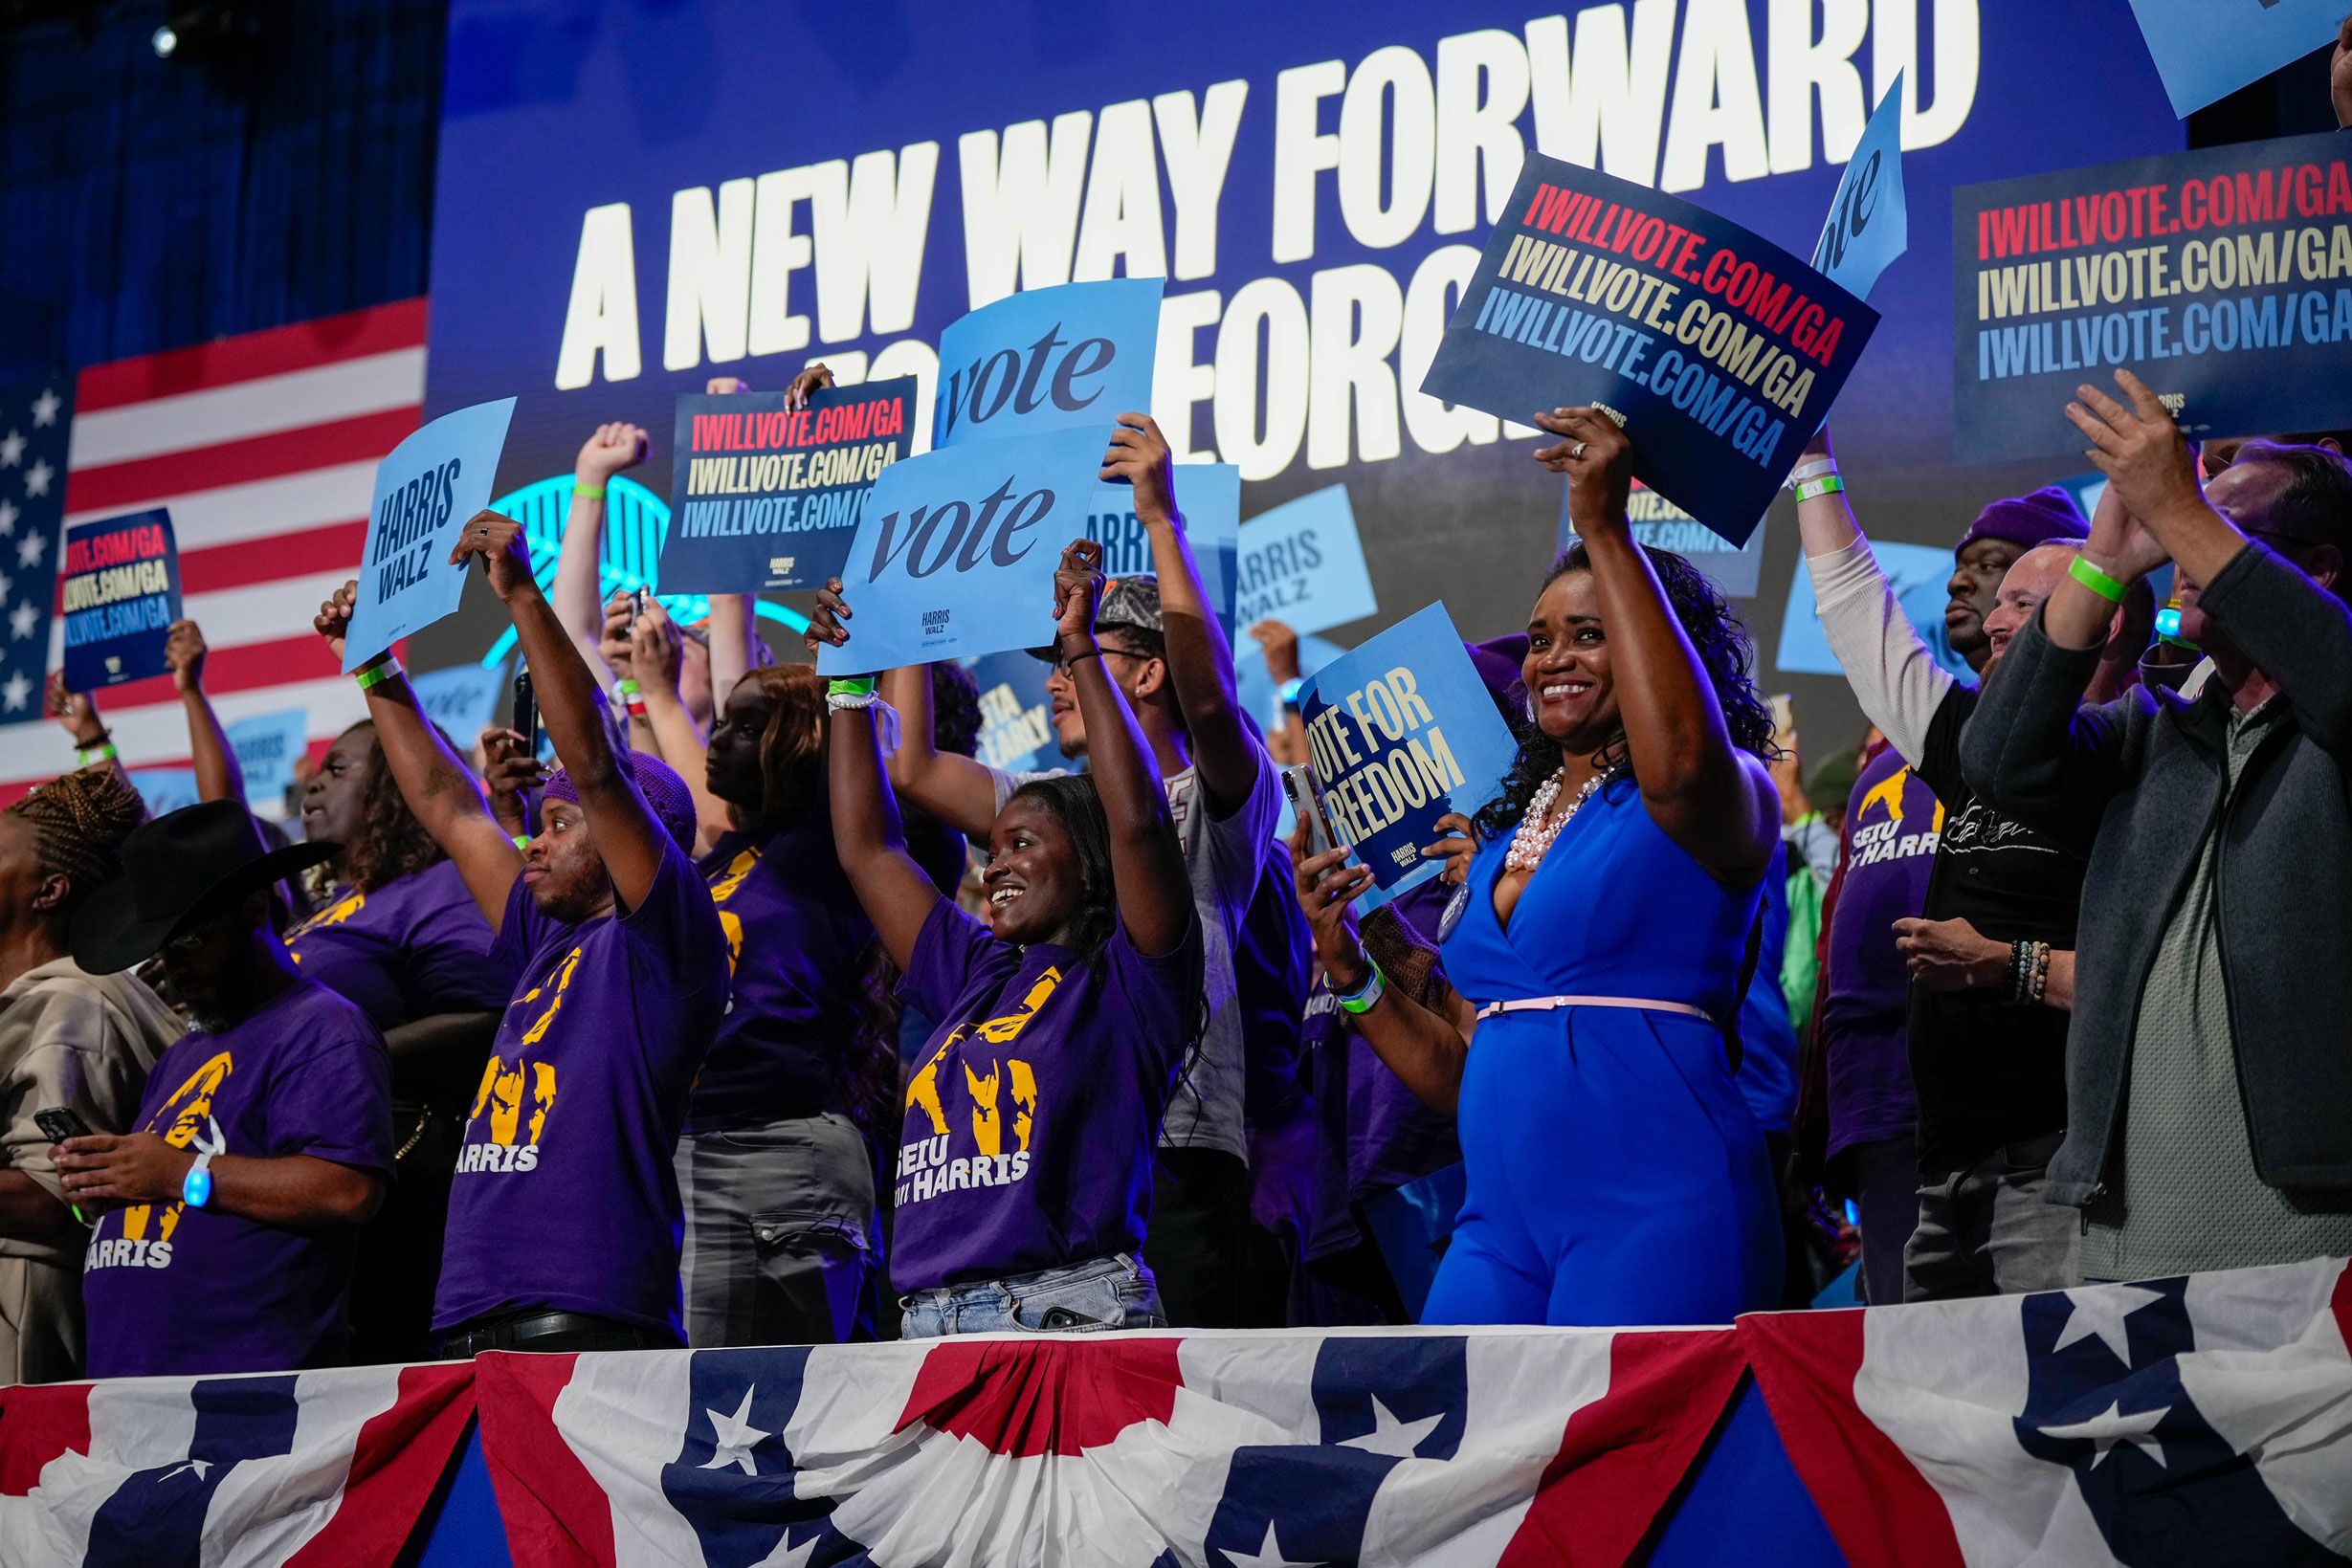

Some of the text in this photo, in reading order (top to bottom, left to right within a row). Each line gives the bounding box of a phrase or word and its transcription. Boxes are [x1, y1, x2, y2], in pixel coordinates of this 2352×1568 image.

[555, 0, 1980, 390] A NEW WAY FORWARD
[1811, 149, 1880, 278] ote
[1977, 161, 2352, 260] IWILLVOTE.COM/GA
[1522, 183, 1845, 367] IWILLVOTE.COM/GA
[1978, 224, 2352, 320] IWILLVOTE.COM/GA
[1498, 233, 1816, 418] IWILLVOTE.COM/GA
[1978, 288, 2352, 381] IWILLVOTE.COM/GA
[947, 321, 1118, 438] vote
[1151, 245, 1543, 481] EORG
[1474, 286, 1786, 469] IWILLVOTE.COM/GA
[692, 397, 904, 453] IWILLVOTE.COM/GA
[2158, 392, 2185, 409] RRIS
[686, 441, 898, 496] IWILLVOTE.COM/GA
[372, 457, 461, 566] HARRIS
[680, 487, 875, 539] IWILLVOTE.COM/
[868, 475, 1056, 585] vote
[378, 539, 433, 605] WALZ
[769, 557, 795, 569] HARRIS
[1236, 529, 1323, 596] RRIS
[921, 608, 950, 627] HARRIS
[924, 625, 944, 635] WALZ
[1345, 666, 1434, 754] FOR
[1390, 842, 1417, 864] HARRIS
[1399, 854, 1417, 868] WALZ
[1859, 831, 1941, 867] HARR
[455, 1143, 540, 1175] ARRIS
[913, 1150, 1031, 1203] HARRIS
[84, 1239, 173, 1274] ARRIS
